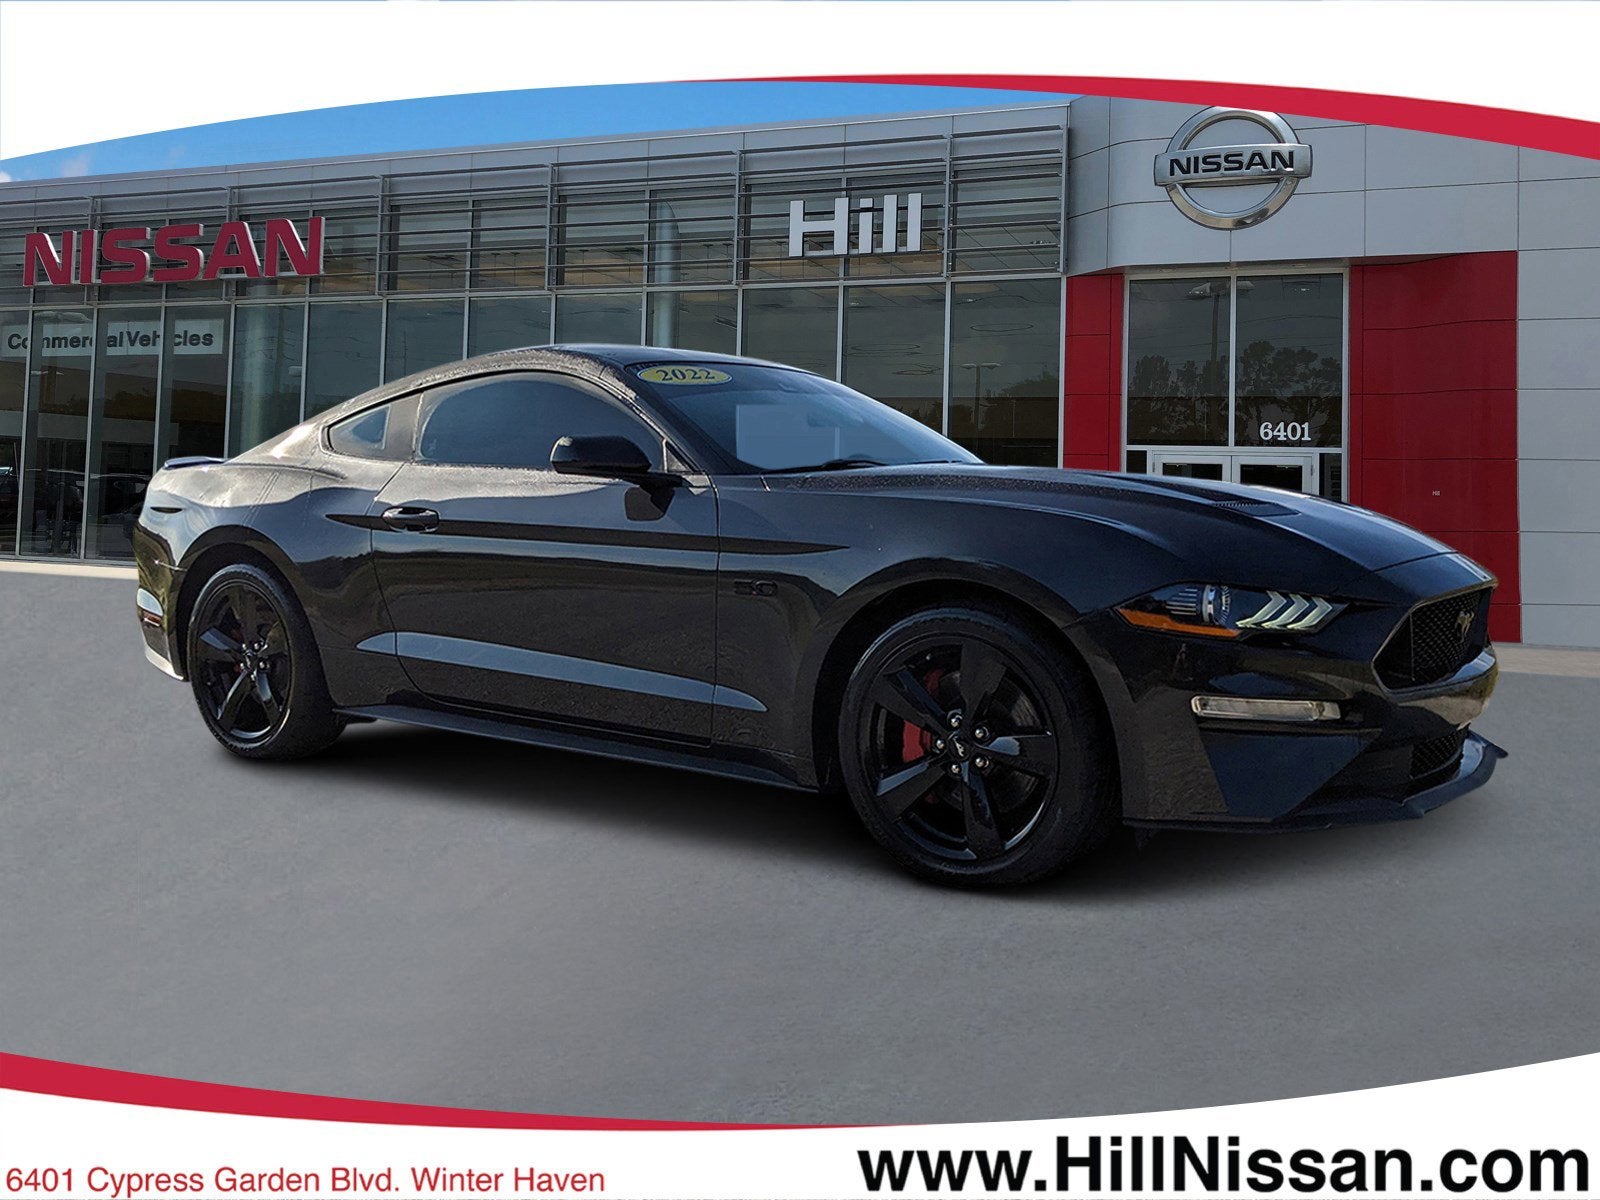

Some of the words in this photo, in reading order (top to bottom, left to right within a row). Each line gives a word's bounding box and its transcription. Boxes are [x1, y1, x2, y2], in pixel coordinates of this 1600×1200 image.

[1169, 151, 1295, 177] NISSAN
[788, 192, 922, 257] Hill
[23, 216, 325, 287] NISSAN
[7, 331, 123, 350] Commeral
[127, 330, 214, 347] Vehcles
[655, 368, 716, 382] 2022
[1259, 422, 1312, 441] 6401
